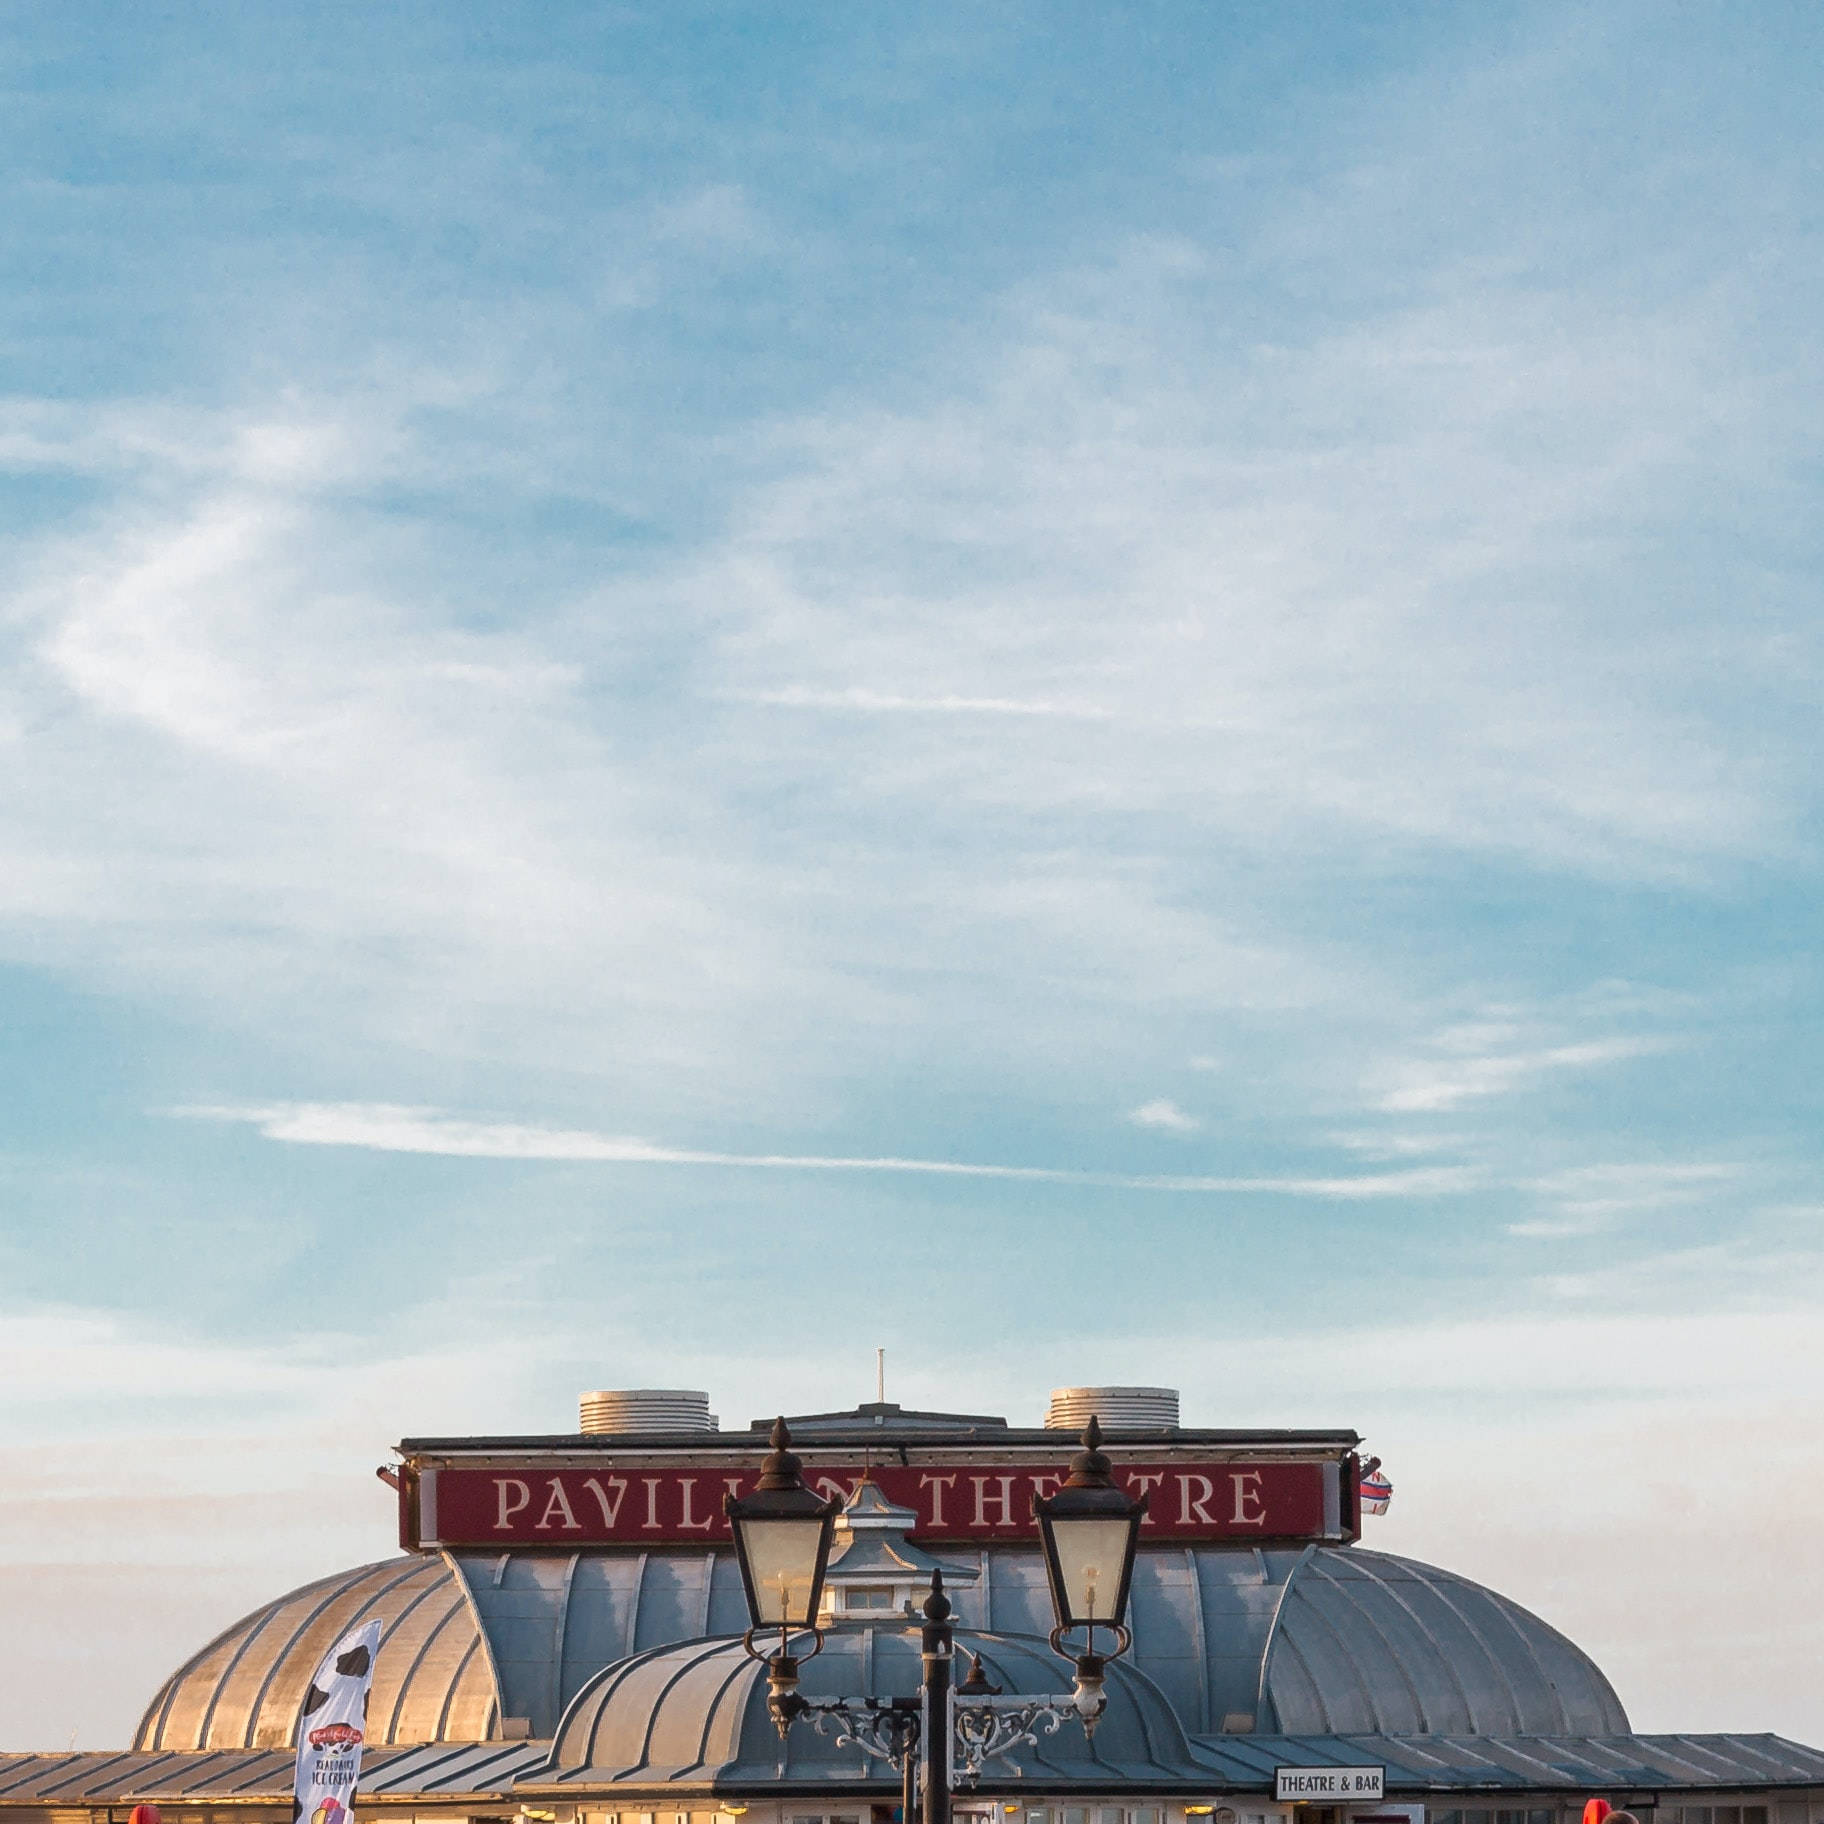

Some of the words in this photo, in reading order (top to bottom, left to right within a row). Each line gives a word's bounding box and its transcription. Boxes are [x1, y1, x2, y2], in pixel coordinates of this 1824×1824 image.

[492, 1475, 869, 1530] PAVILIN
[920, 1471, 1267, 1527] THETRE
[312, 1771, 325, 1785] ICE
[1281, 1776, 1335, 1791] THEATRE
[1340, 1776, 1351, 1791] &
[1356, 1776, 1380, 1791] BAR
